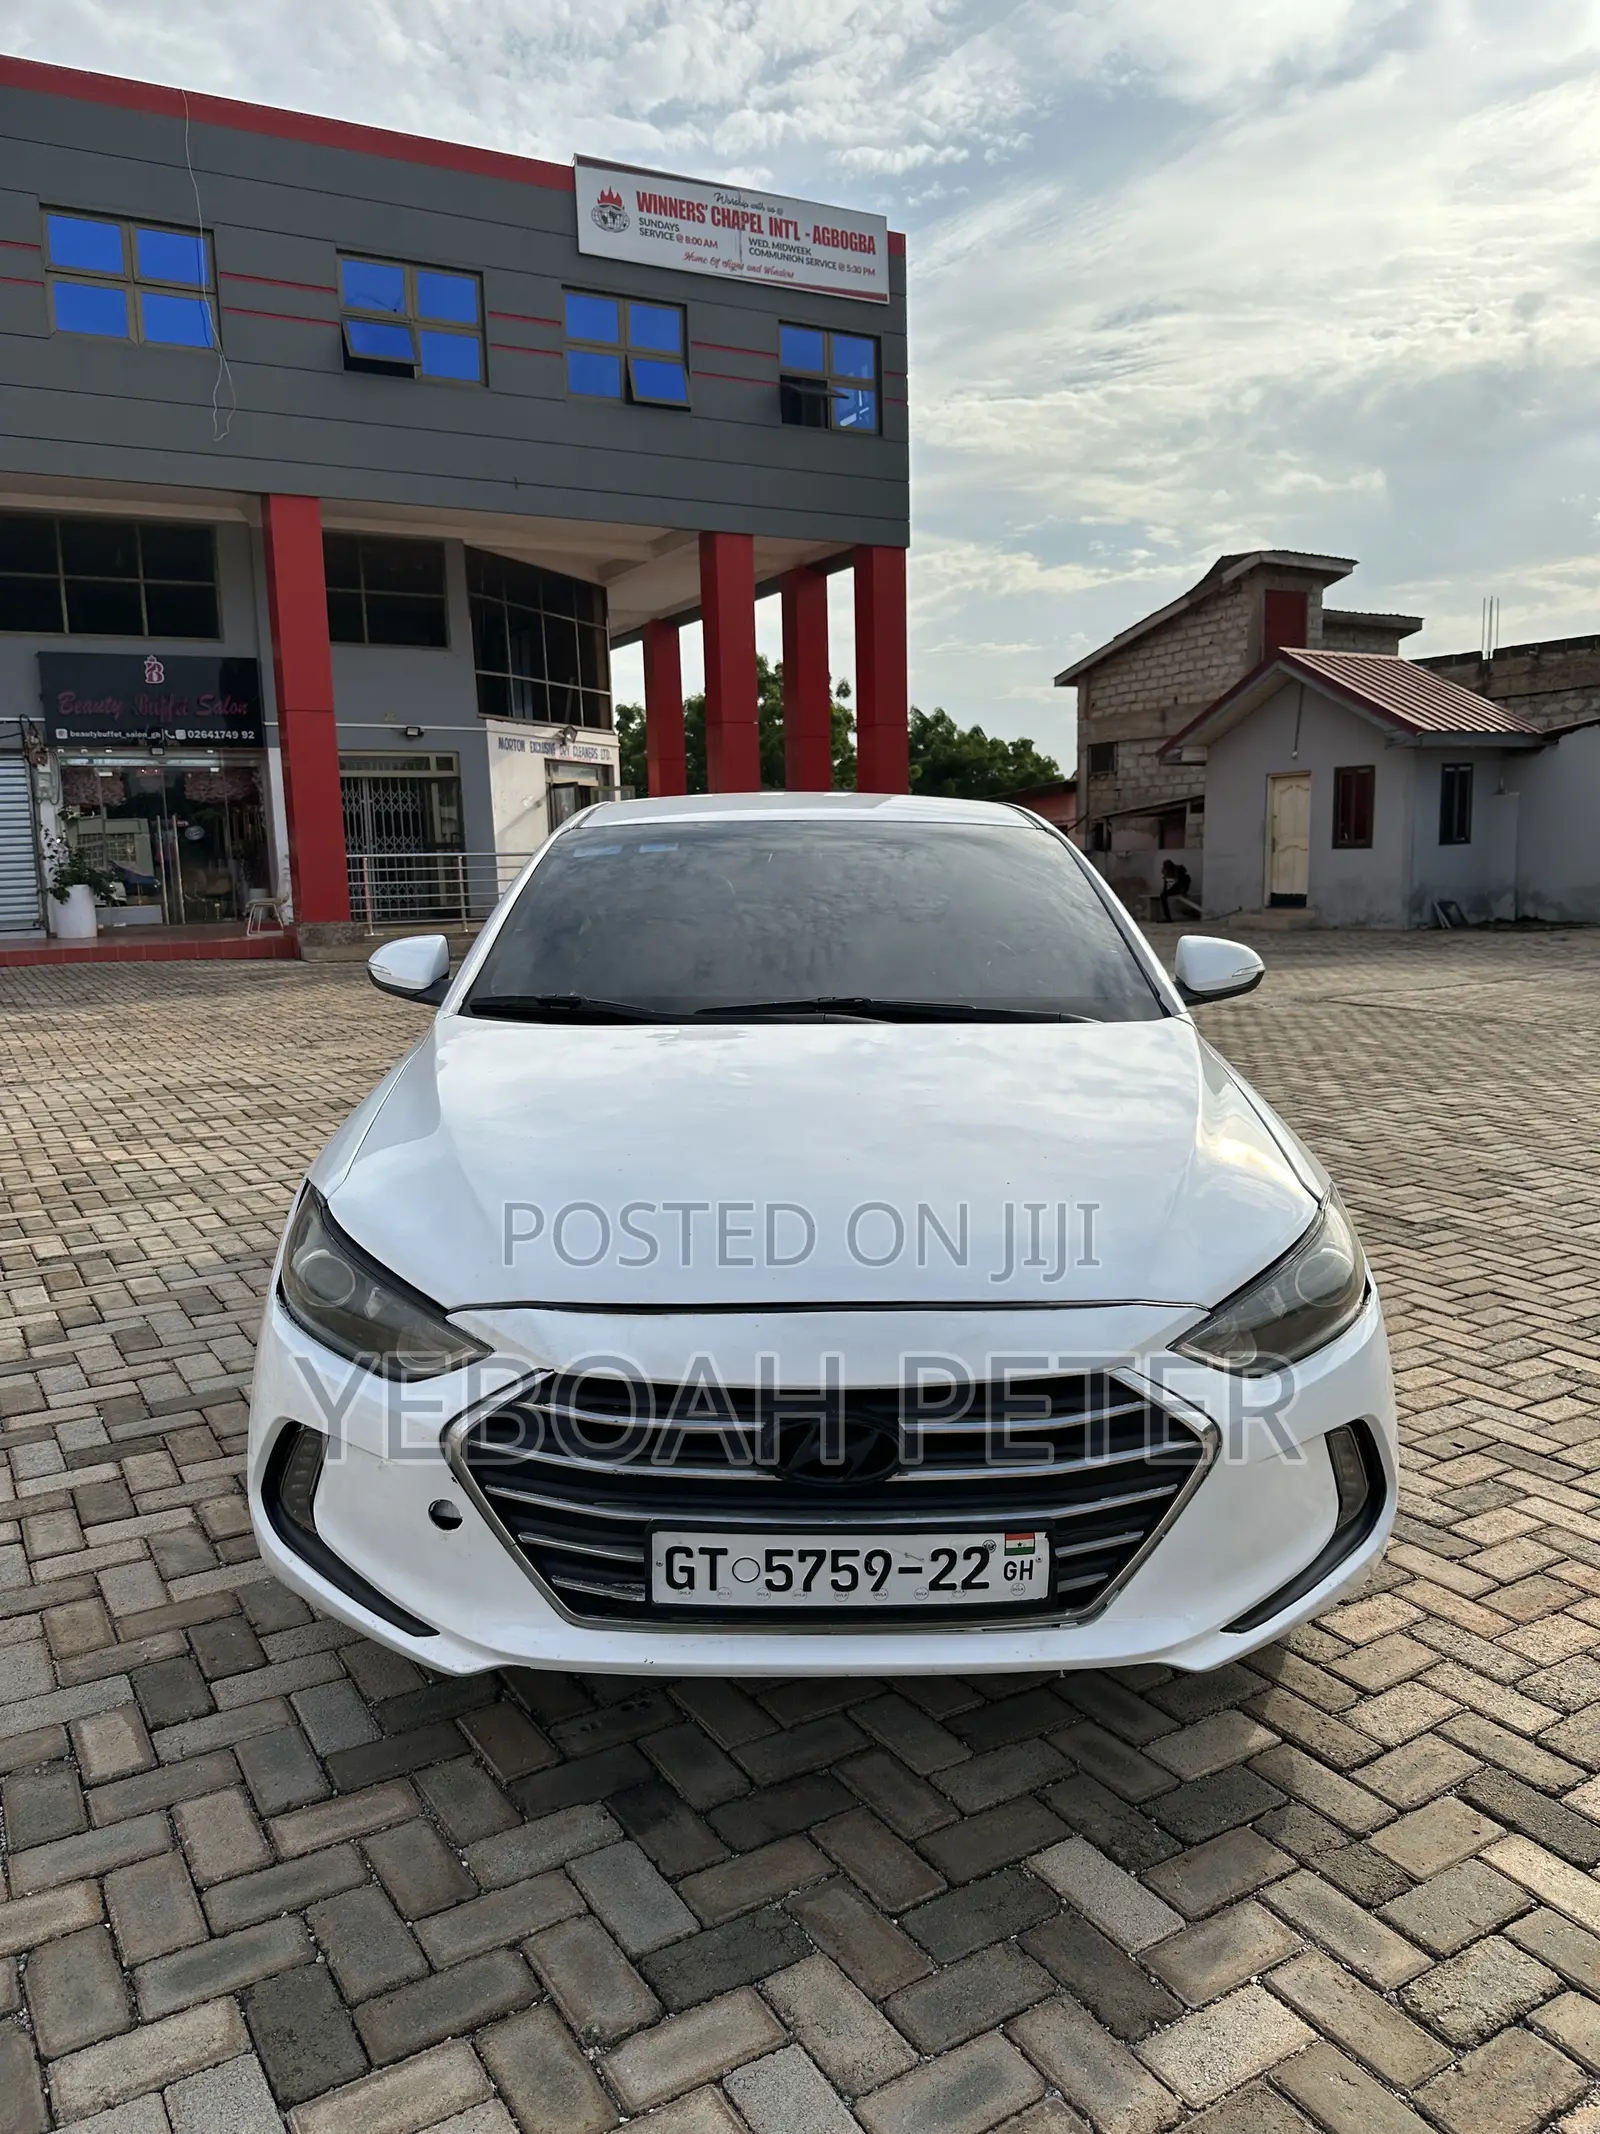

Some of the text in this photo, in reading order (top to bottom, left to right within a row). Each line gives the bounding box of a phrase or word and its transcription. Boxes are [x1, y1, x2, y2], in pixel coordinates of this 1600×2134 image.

[636, 190, 708, 224] WINNERS'
[711, 205, 764, 235] CHAPEL
[768, 216, 801, 242] INT'L
[812, 224, 876, 255] AGBOGBA
[639, 217, 680, 232] SUNDAYS
[639, 227, 718, 249] SERVICE @ 8:00 AM
[748, 236, 812, 256] WED. MIDWEEK
[682, 251, 708, 265] Home
[748, 247, 804, 264] COMMUNION
[805, 256, 837, 270] SERVICE
[846, 264, 862, 274] 5:30
[863, 267, 876, 277] PM
[57, 690, 123, 721] Beauty
[195, 693, 249, 716] Salon
[498, 736, 525, 753] MORTON
[572, 745, 598, 760] CLEANERS
[665, 1545, 990, 1592] GT 5759-22
[1003, 1560, 1033, 1581] GH
